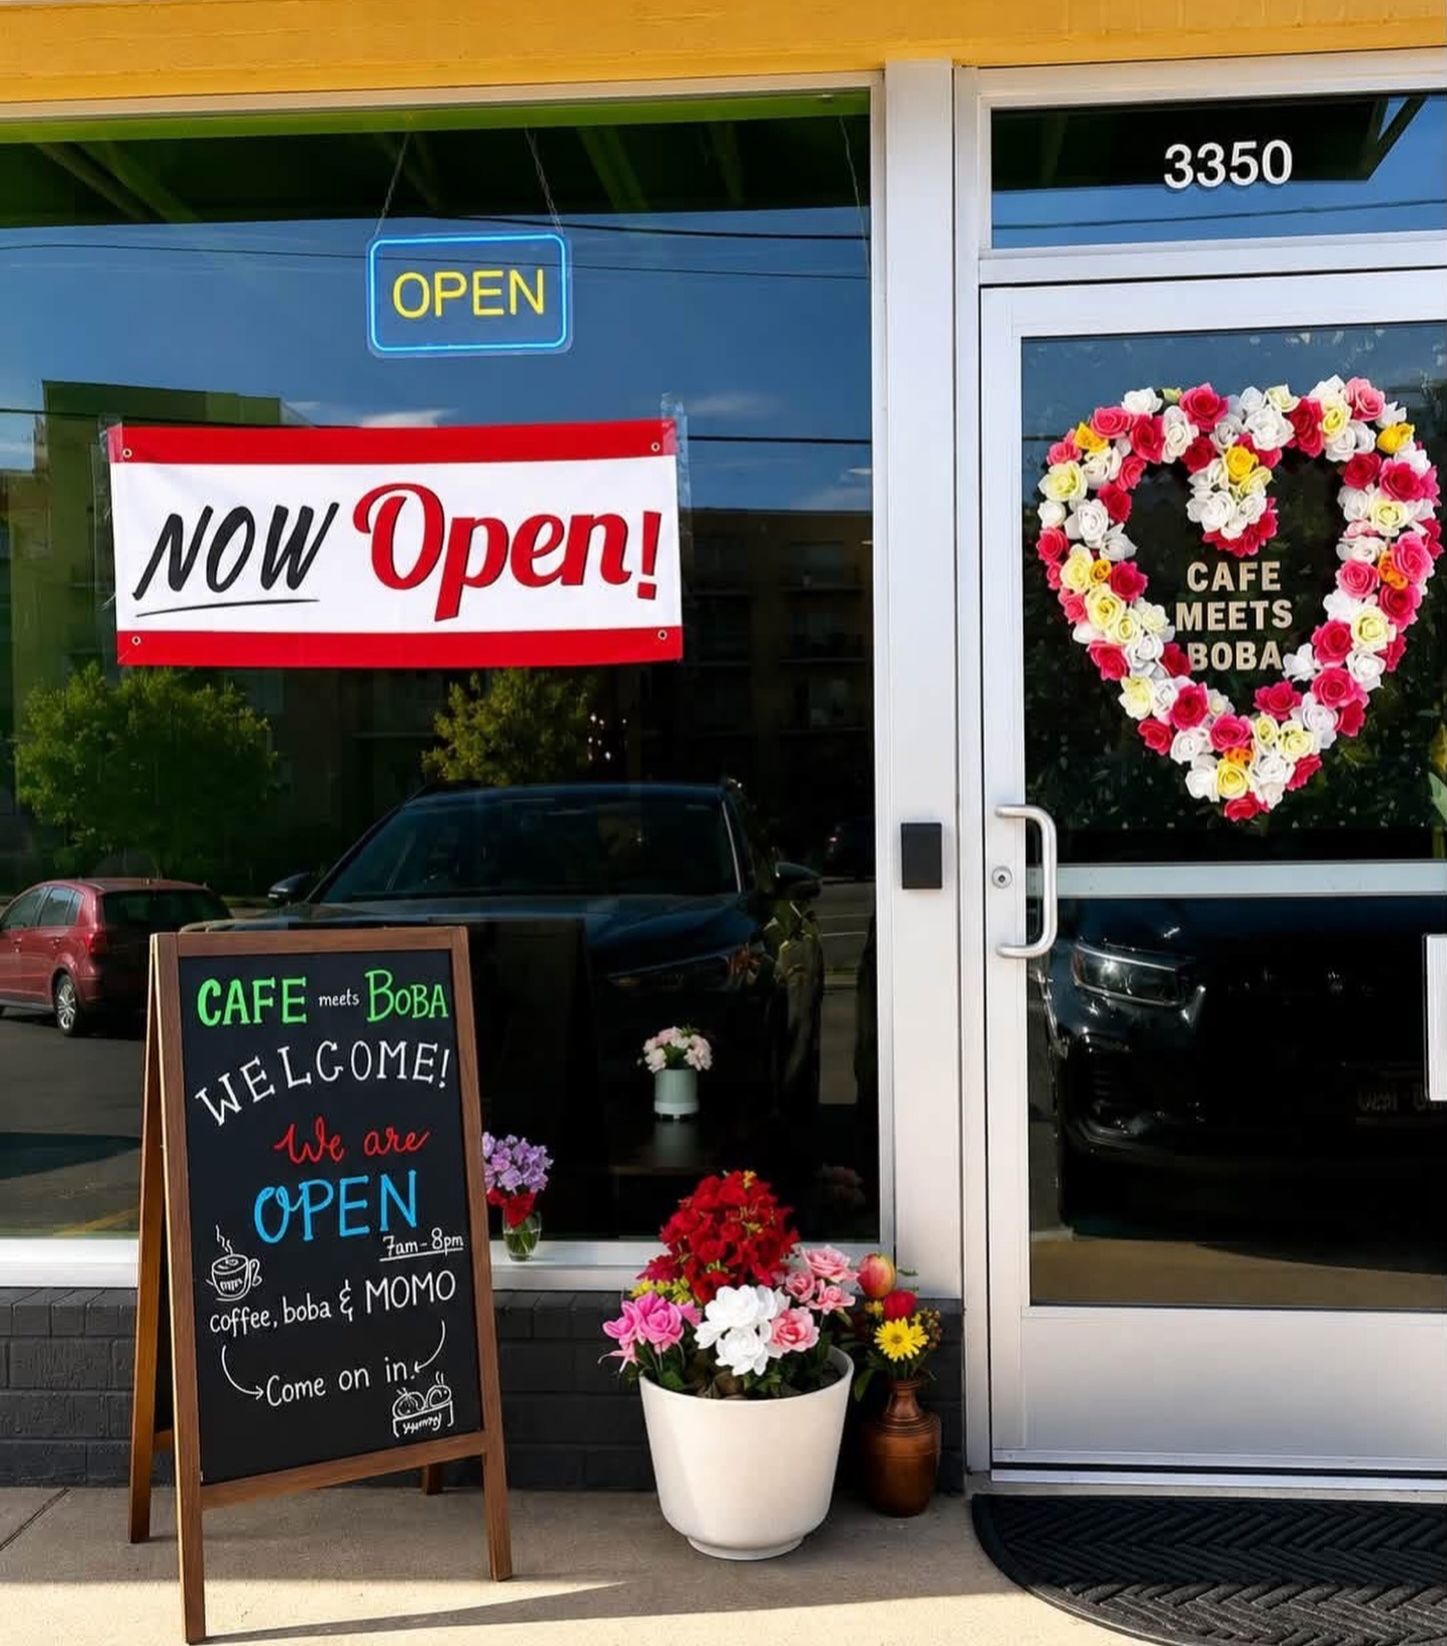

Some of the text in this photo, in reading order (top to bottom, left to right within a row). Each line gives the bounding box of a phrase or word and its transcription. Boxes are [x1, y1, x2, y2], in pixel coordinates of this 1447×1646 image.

[1164, 139, 1293, 189] 3350
[392, 268, 545, 319] OPEN
[131, 483, 661, 622] NOW Open!
[1186, 561, 1282, 592] CAFE
[1175, 599, 1293, 632] MEETS
[1187, 641, 1283, 671] BOBA
[197, 969, 449, 1027] CAFE meets BOBA
[195, 1040, 451, 1126] WELCOME!
[273, 1116, 431, 1164] We are
[254, 1169, 417, 1244] OPEN
[210, 1306, 278, 1338] coffee,
[283, 1293, 332, 1324] boba
[366, 1269, 456, 1314] MOMO
[266, 1374, 326, 1407] Come
[338, 1367, 370, 1391] on
